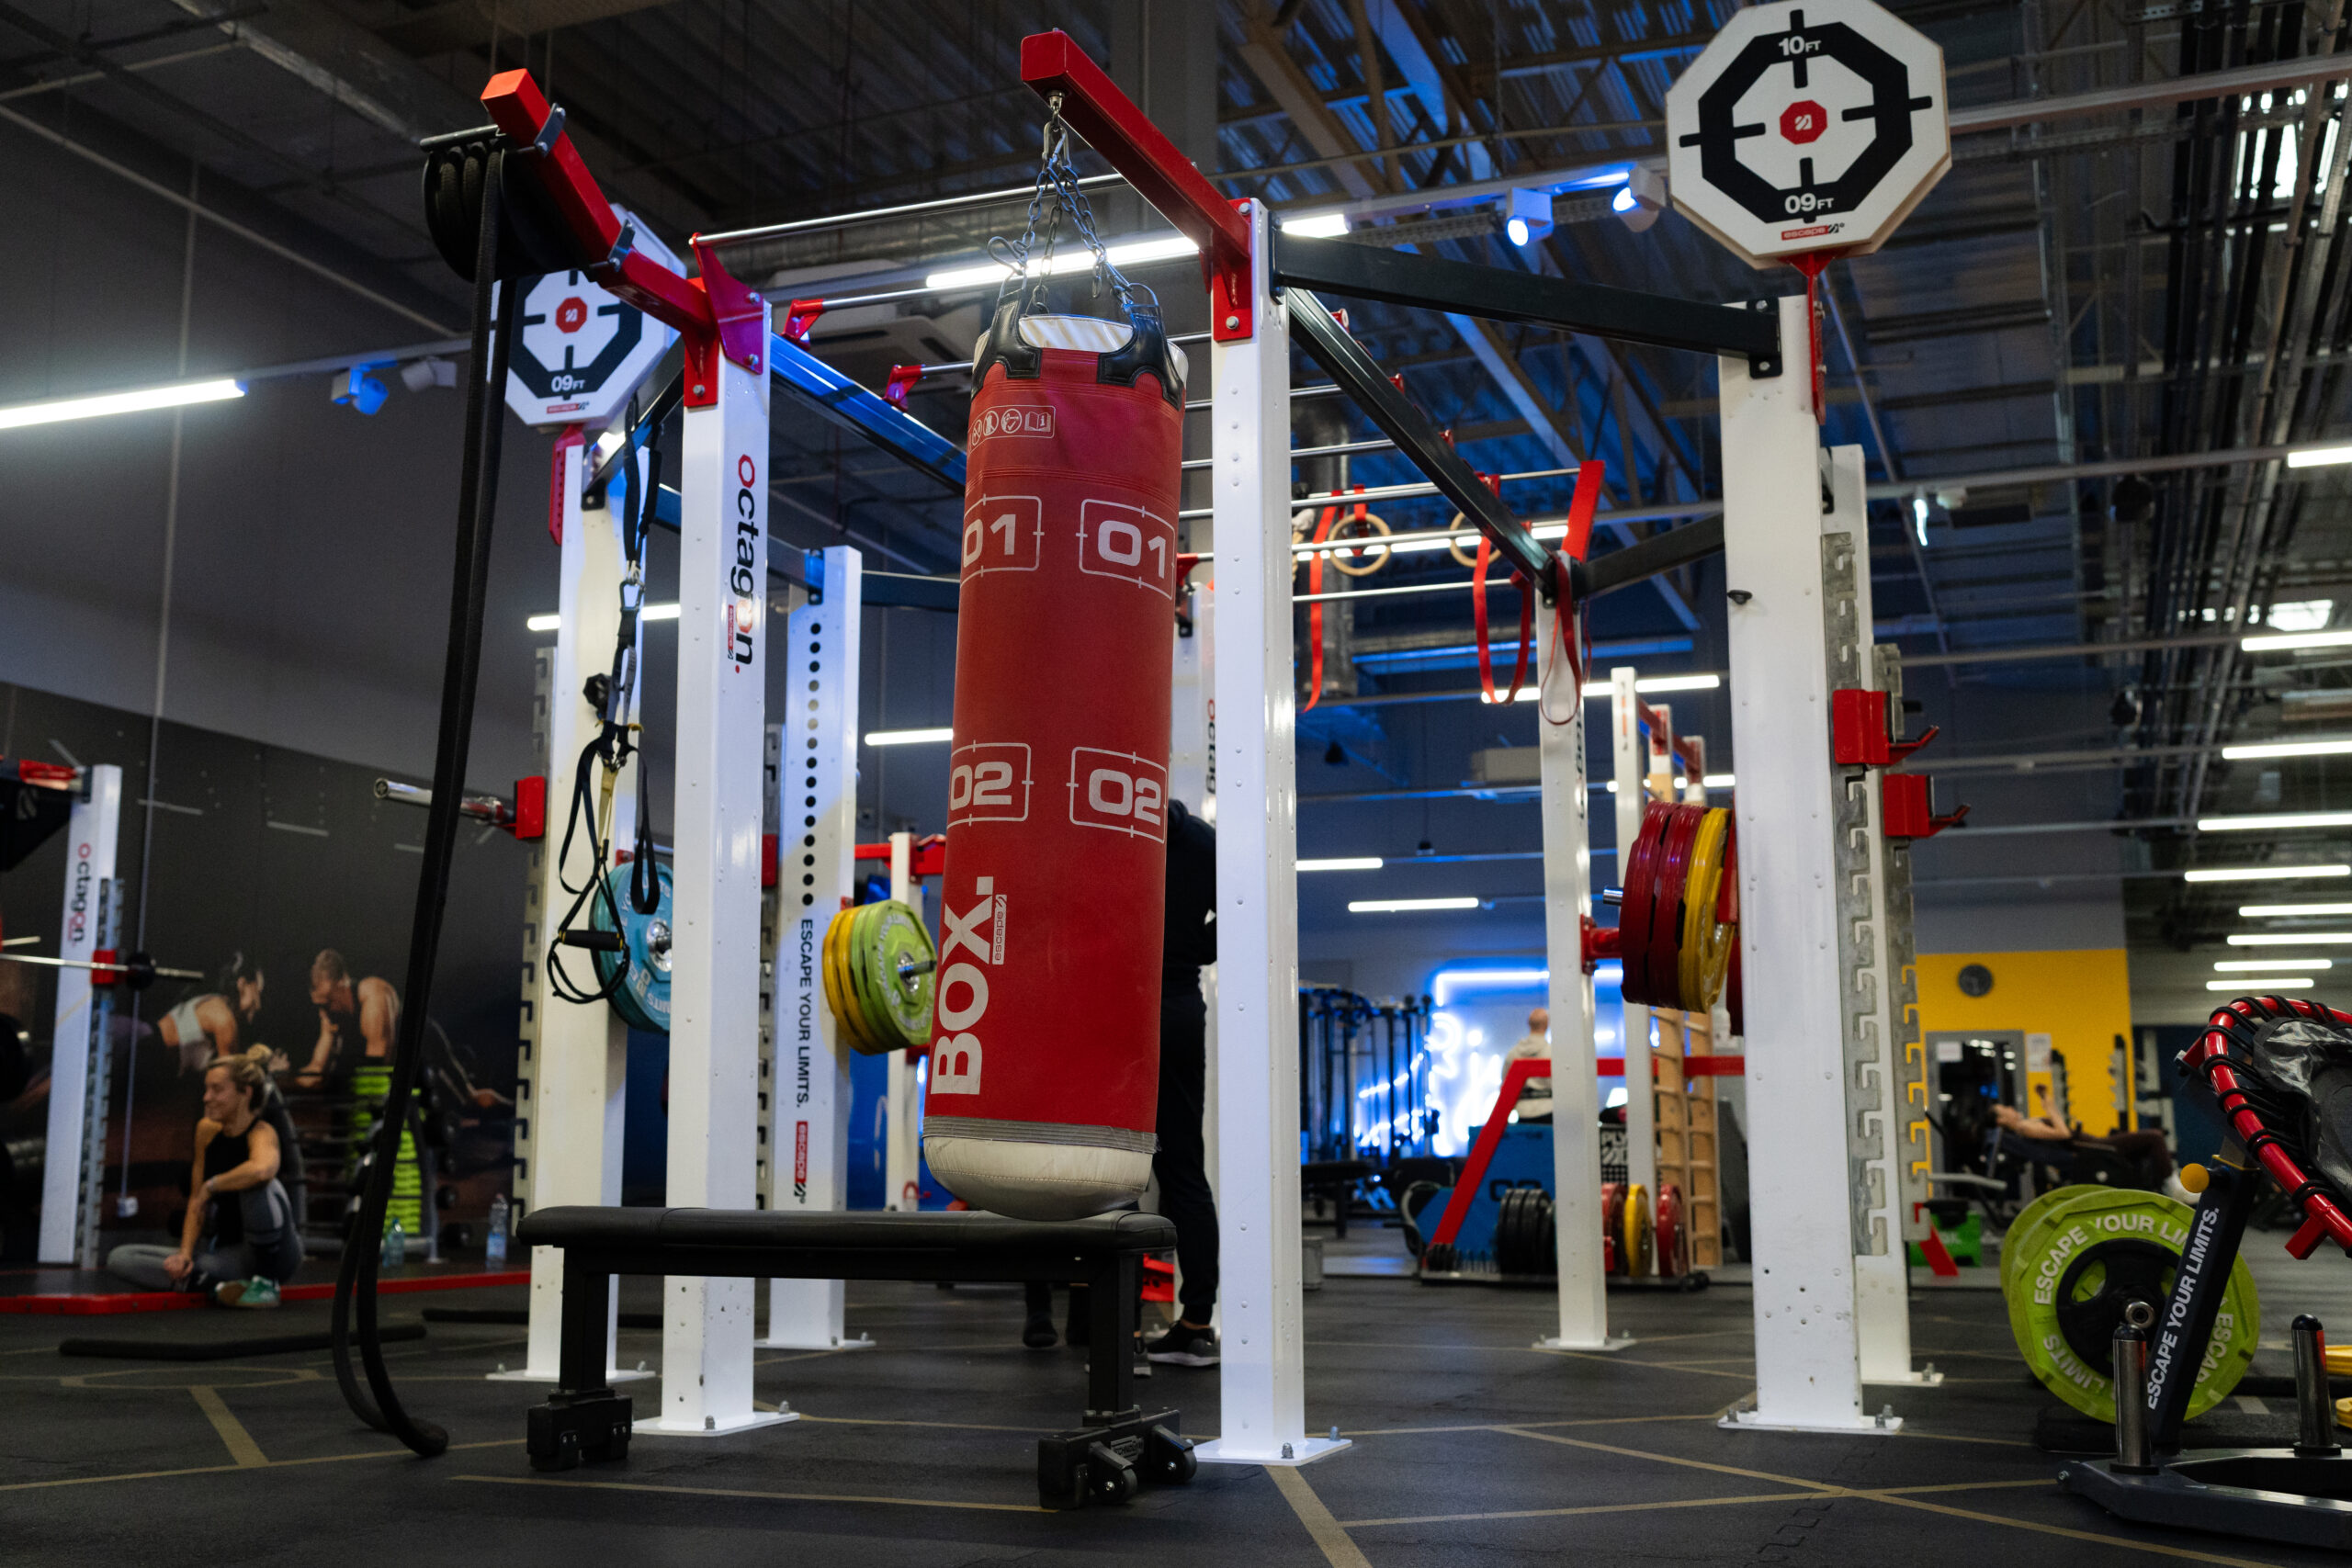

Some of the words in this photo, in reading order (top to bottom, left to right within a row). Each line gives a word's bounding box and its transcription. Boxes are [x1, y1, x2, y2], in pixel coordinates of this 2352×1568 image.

[1782, 226, 1827, 239] escape
[964, 513, 1016, 568] 01
[1098, 520, 1167, 580] 01
[950, 761, 1012, 811] 02
[1089, 768, 1161, 826] 02
[799, 919, 813, 987] ESCAPE
[994, 910, 1004, 961] escape
[797, 993, 811, 1041] YOUR
[796, 1046, 810, 1108] LIMITS.
[797, 1123, 807, 1179] escape
[2034, 1225, 2089, 1305] ESCAPE
[2147, 1330, 2178, 1410] ESCAPE
[2166, 1275, 2196, 1328] YOUR
[2185, 1208, 2220, 1275] LIMITS.
